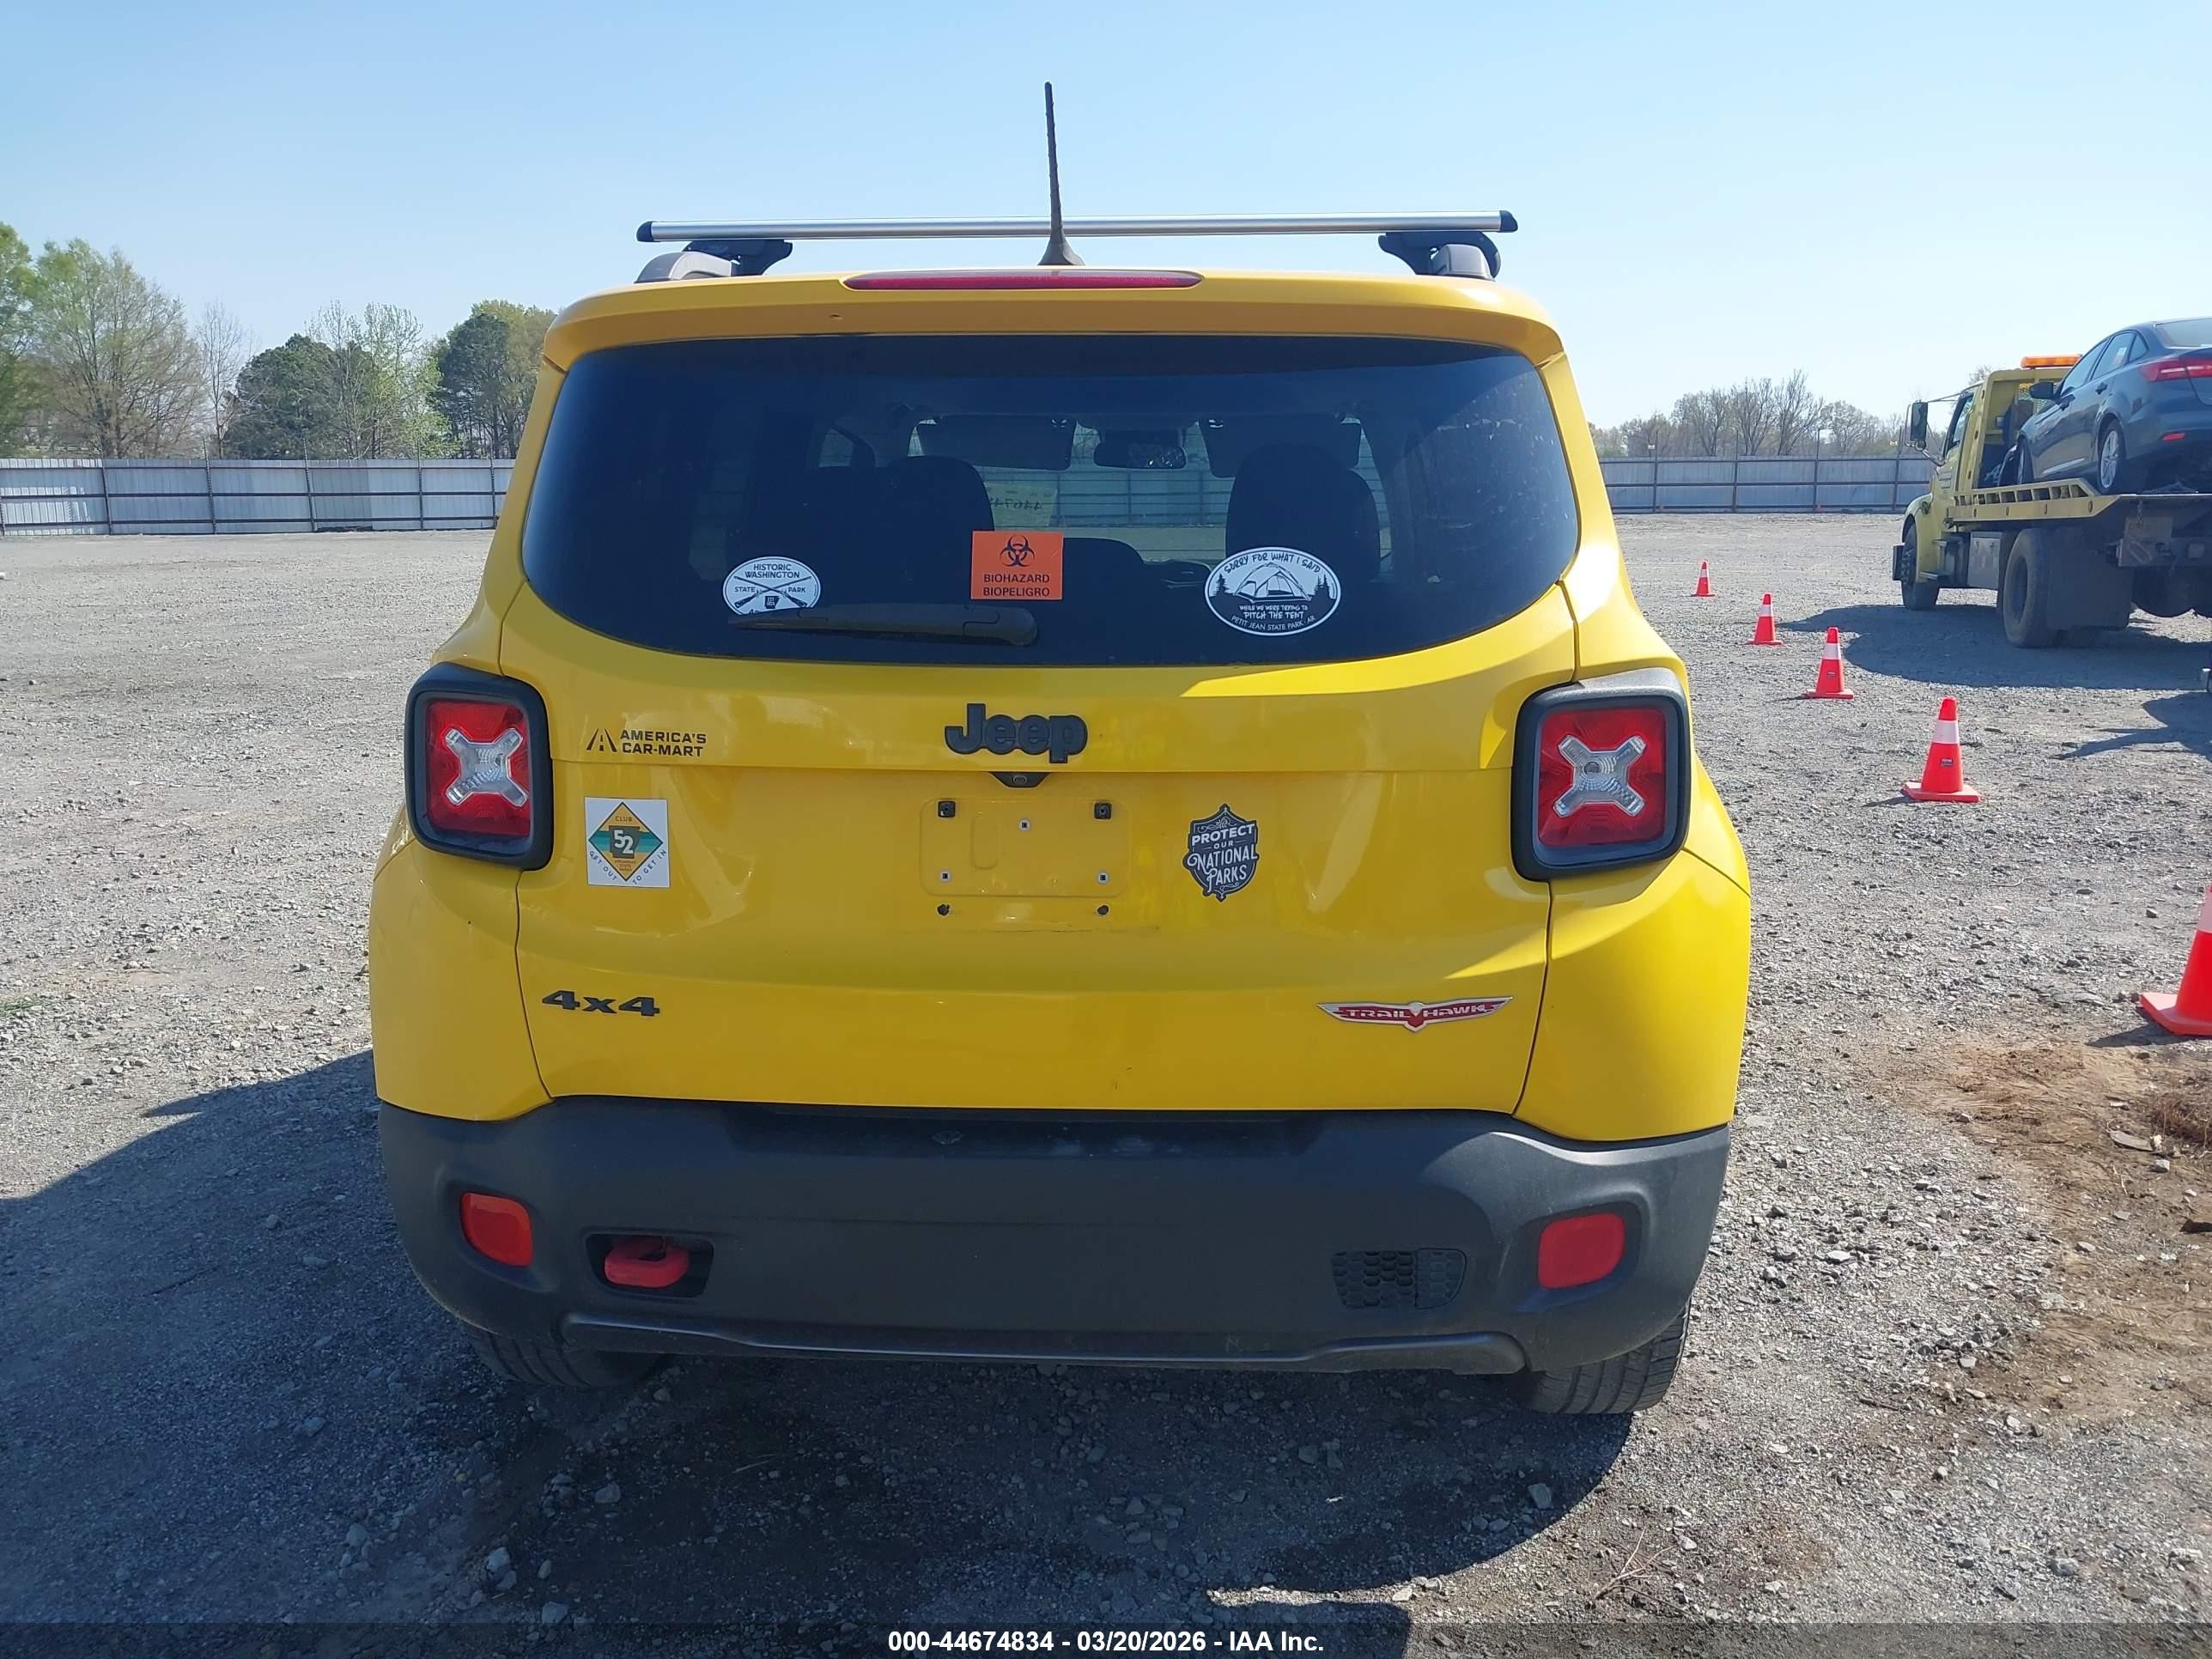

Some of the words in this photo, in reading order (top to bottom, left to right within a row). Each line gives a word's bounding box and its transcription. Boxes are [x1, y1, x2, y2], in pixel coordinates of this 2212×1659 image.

[1224, 553, 1249, 574] SORRY
[1252, 553, 1269, 562] FOR
[1271, 552, 1294, 563] WHAT
[1302, 559, 1321, 573] SAID
[984, 574, 1050, 583] BIOHAZARD
[983, 587, 1050, 597] BIOPELIGRO
[1231, 615, 1248, 626] PETIT
[1248, 621, 1266, 630] JEAN
[1288, 621, 1304, 629] PARK
[1307, 615, 1316, 623] AR
[1285, 611, 1304, 619] TENT
[620, 729, 706, 744] AMERICA'S
[945, 703, 1088, 764] Jeep
[622, 743, 704, 757] CAR-MART
[614, 830, 633, 854] 52
[1192, 823, 1255, 846] PROTECT
[1214, 840, 1234, 849] OUR
[589, 851, 602, 864] GET
[603, 866, 618, 880] OUT
[632, 875, 642, 884] TO
[643, 860, 656, 874] GET
[657, 850, 667, 859] IN
[1187, 844, 1257, 875] NATIONAL
[1206, 865, 1247, 893] PARKS
[542, 990, 660, 1017] 4x4
